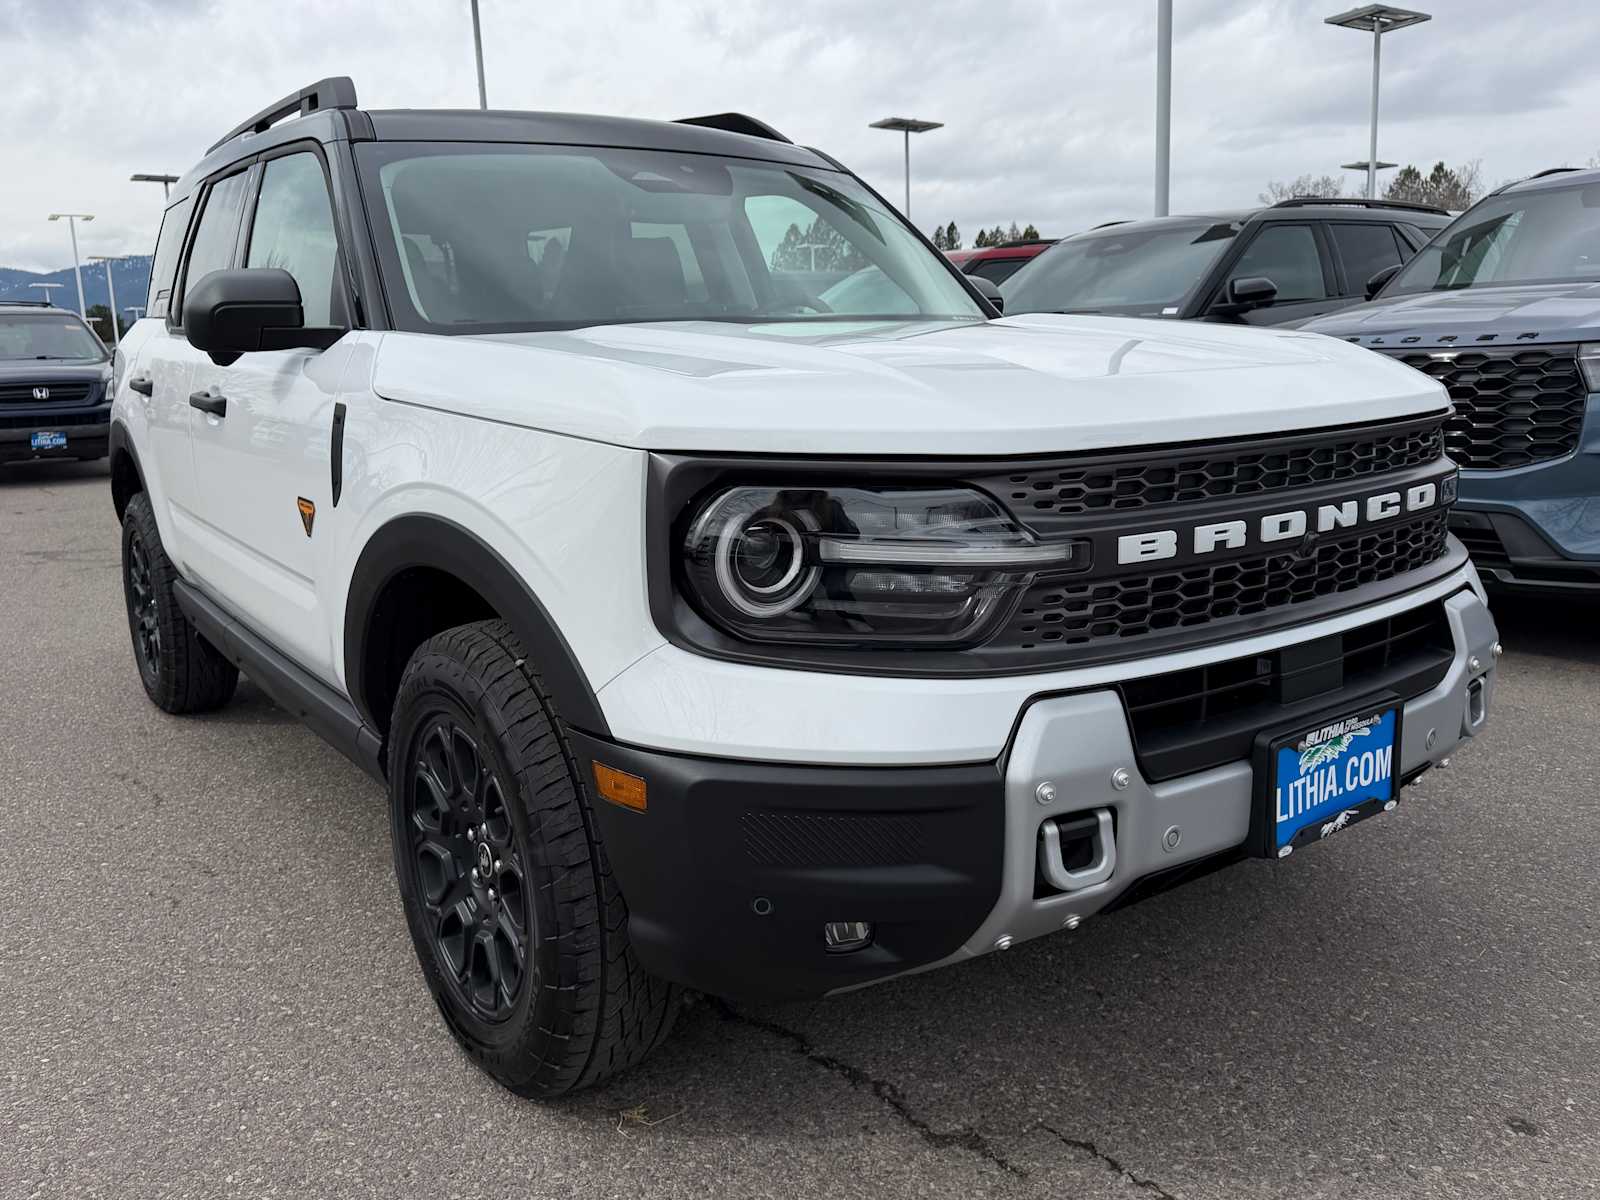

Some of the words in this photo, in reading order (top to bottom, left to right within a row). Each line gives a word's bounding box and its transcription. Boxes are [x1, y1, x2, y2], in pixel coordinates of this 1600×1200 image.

[1117, 483, 1437, 565] BRONCO
[1314, 721, 1345, 743] LITHIA
[1276, 745, 1393, 823] LITHIA.COM
